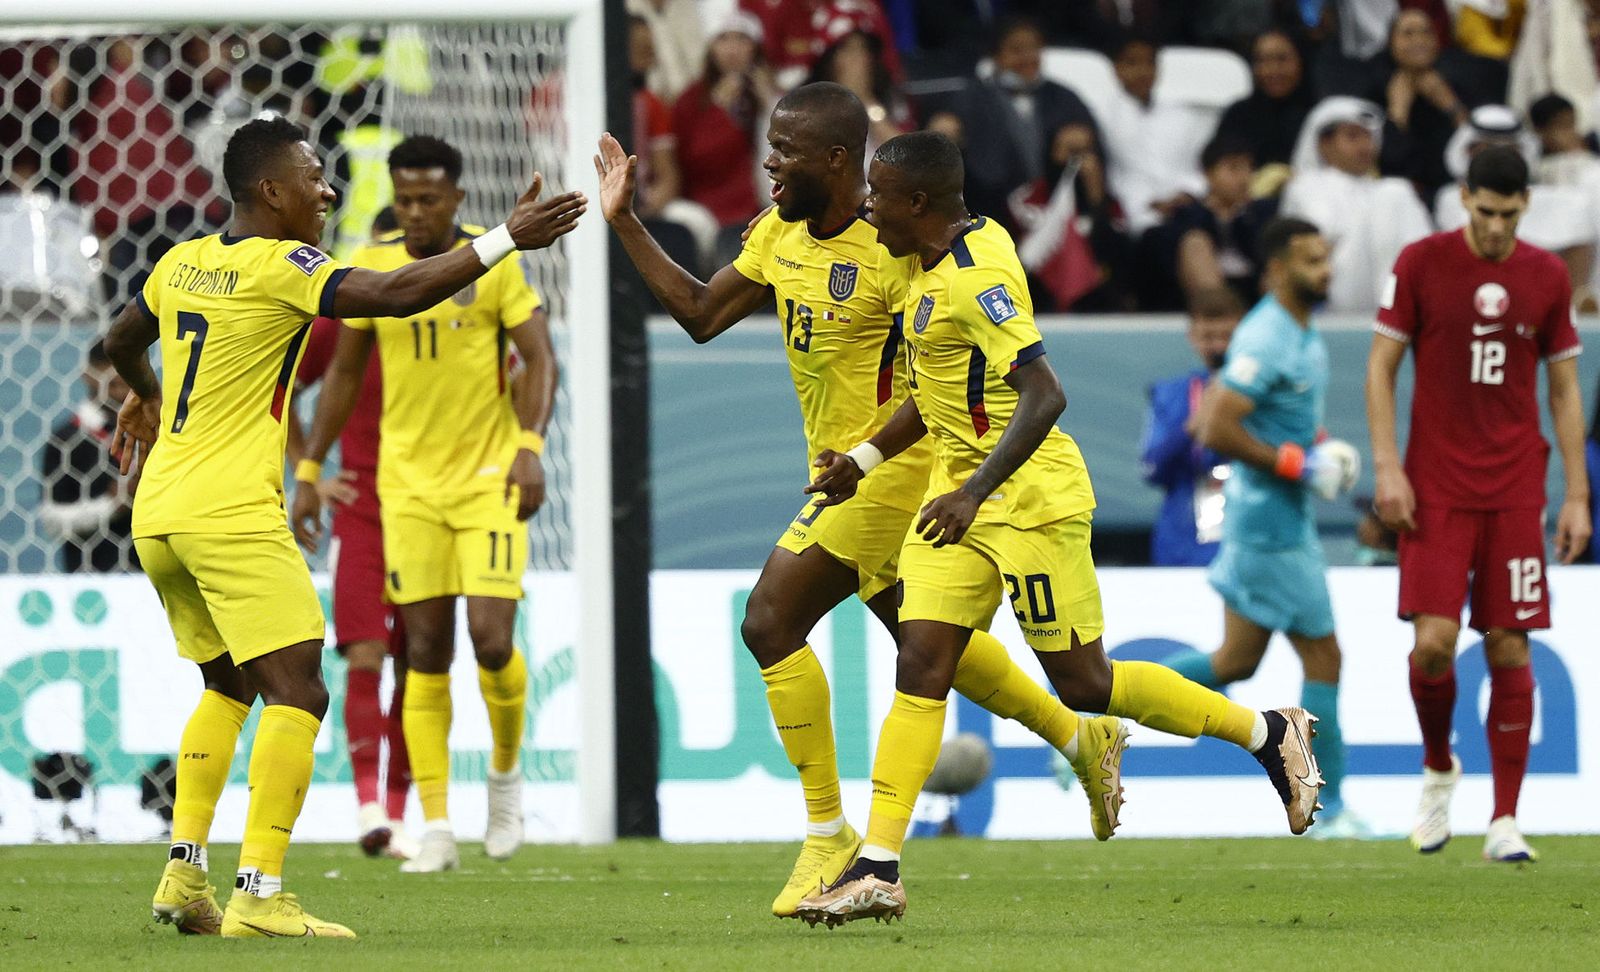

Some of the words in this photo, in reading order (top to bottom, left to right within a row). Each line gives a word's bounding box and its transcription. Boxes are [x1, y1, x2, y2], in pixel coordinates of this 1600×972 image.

[168, 262, 239, 296] ESTUPIÑAN
[410, 320, 438, 360] 11
[785, 298, 813, 354] 13
[171, 310, 210, 434] 7
[1470, 340, 1506, 385] 12
[488, 531, 513, 571] 11
[1002, 573, 1056, 624] 20
[1507, 557, 1542, 603] 12
[184, 752, 210, 760] FEF
